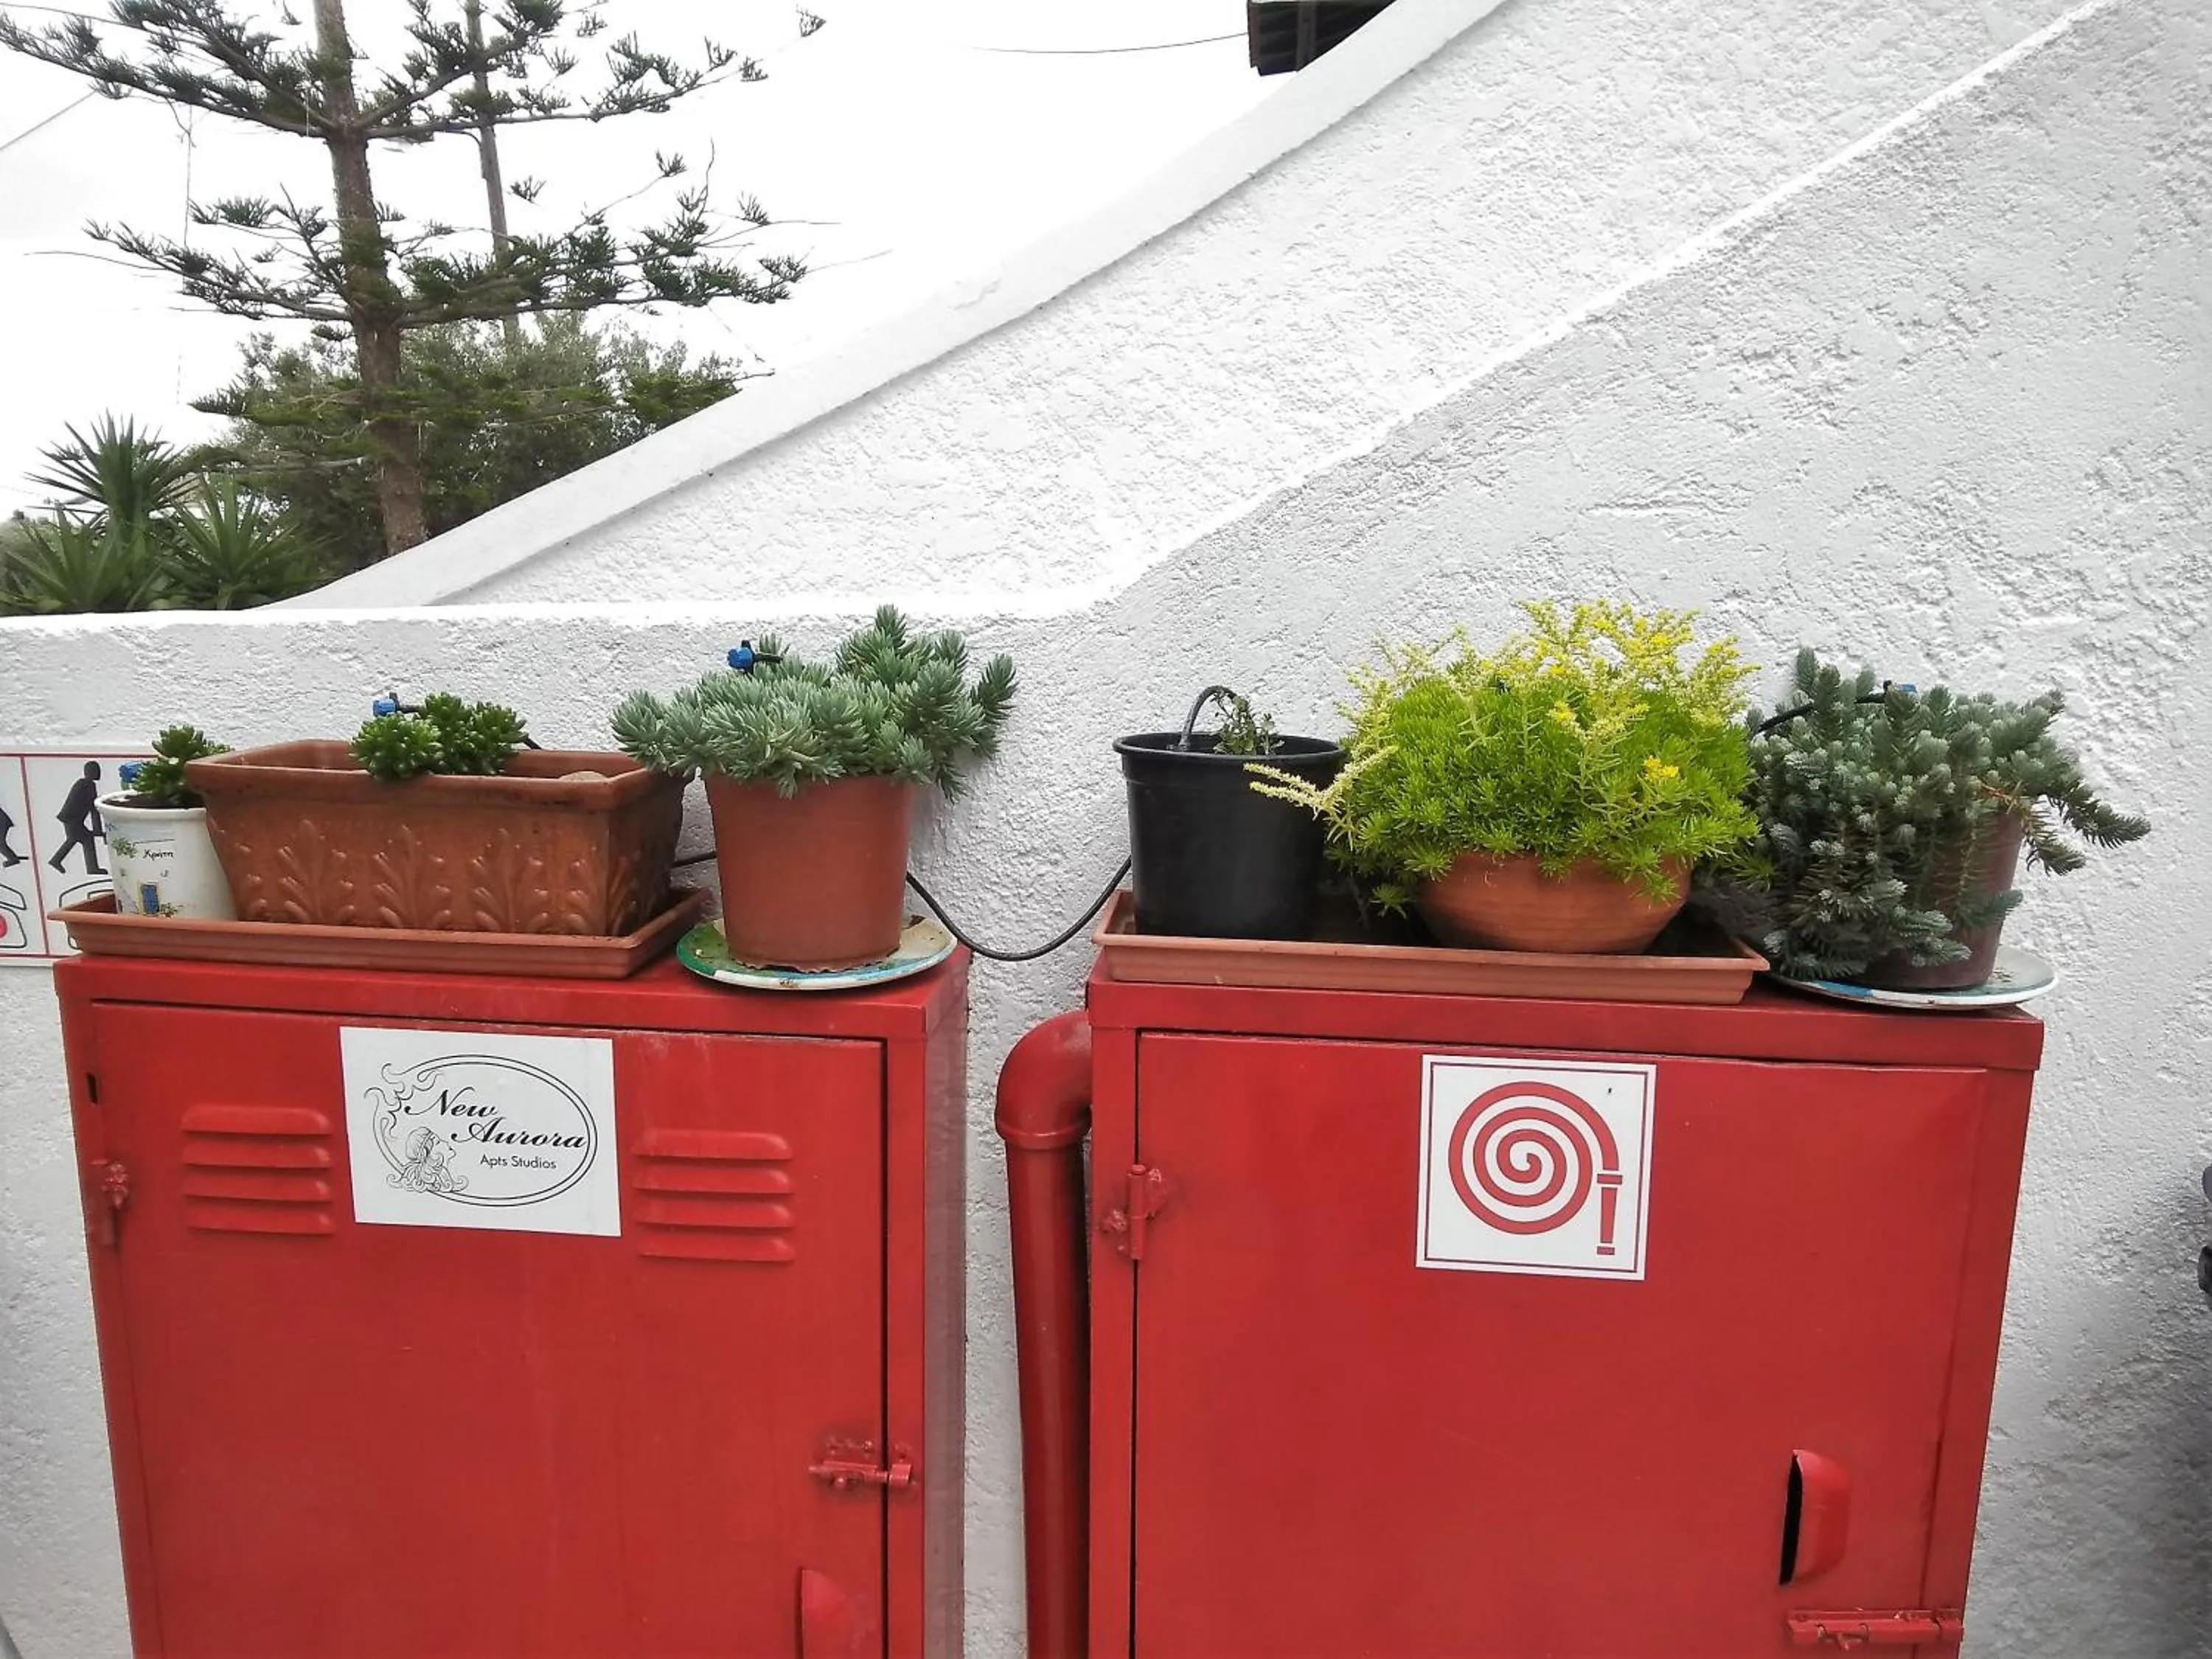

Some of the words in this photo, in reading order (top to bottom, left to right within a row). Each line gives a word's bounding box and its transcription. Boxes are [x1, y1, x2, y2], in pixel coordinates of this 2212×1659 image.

[404, 1086, 498, 1117] New
[451, 1116, 587, 1148] Aurora
[480, 1153, 508, 1169] Apts
[511, 1155, 557, 1170] Studios
